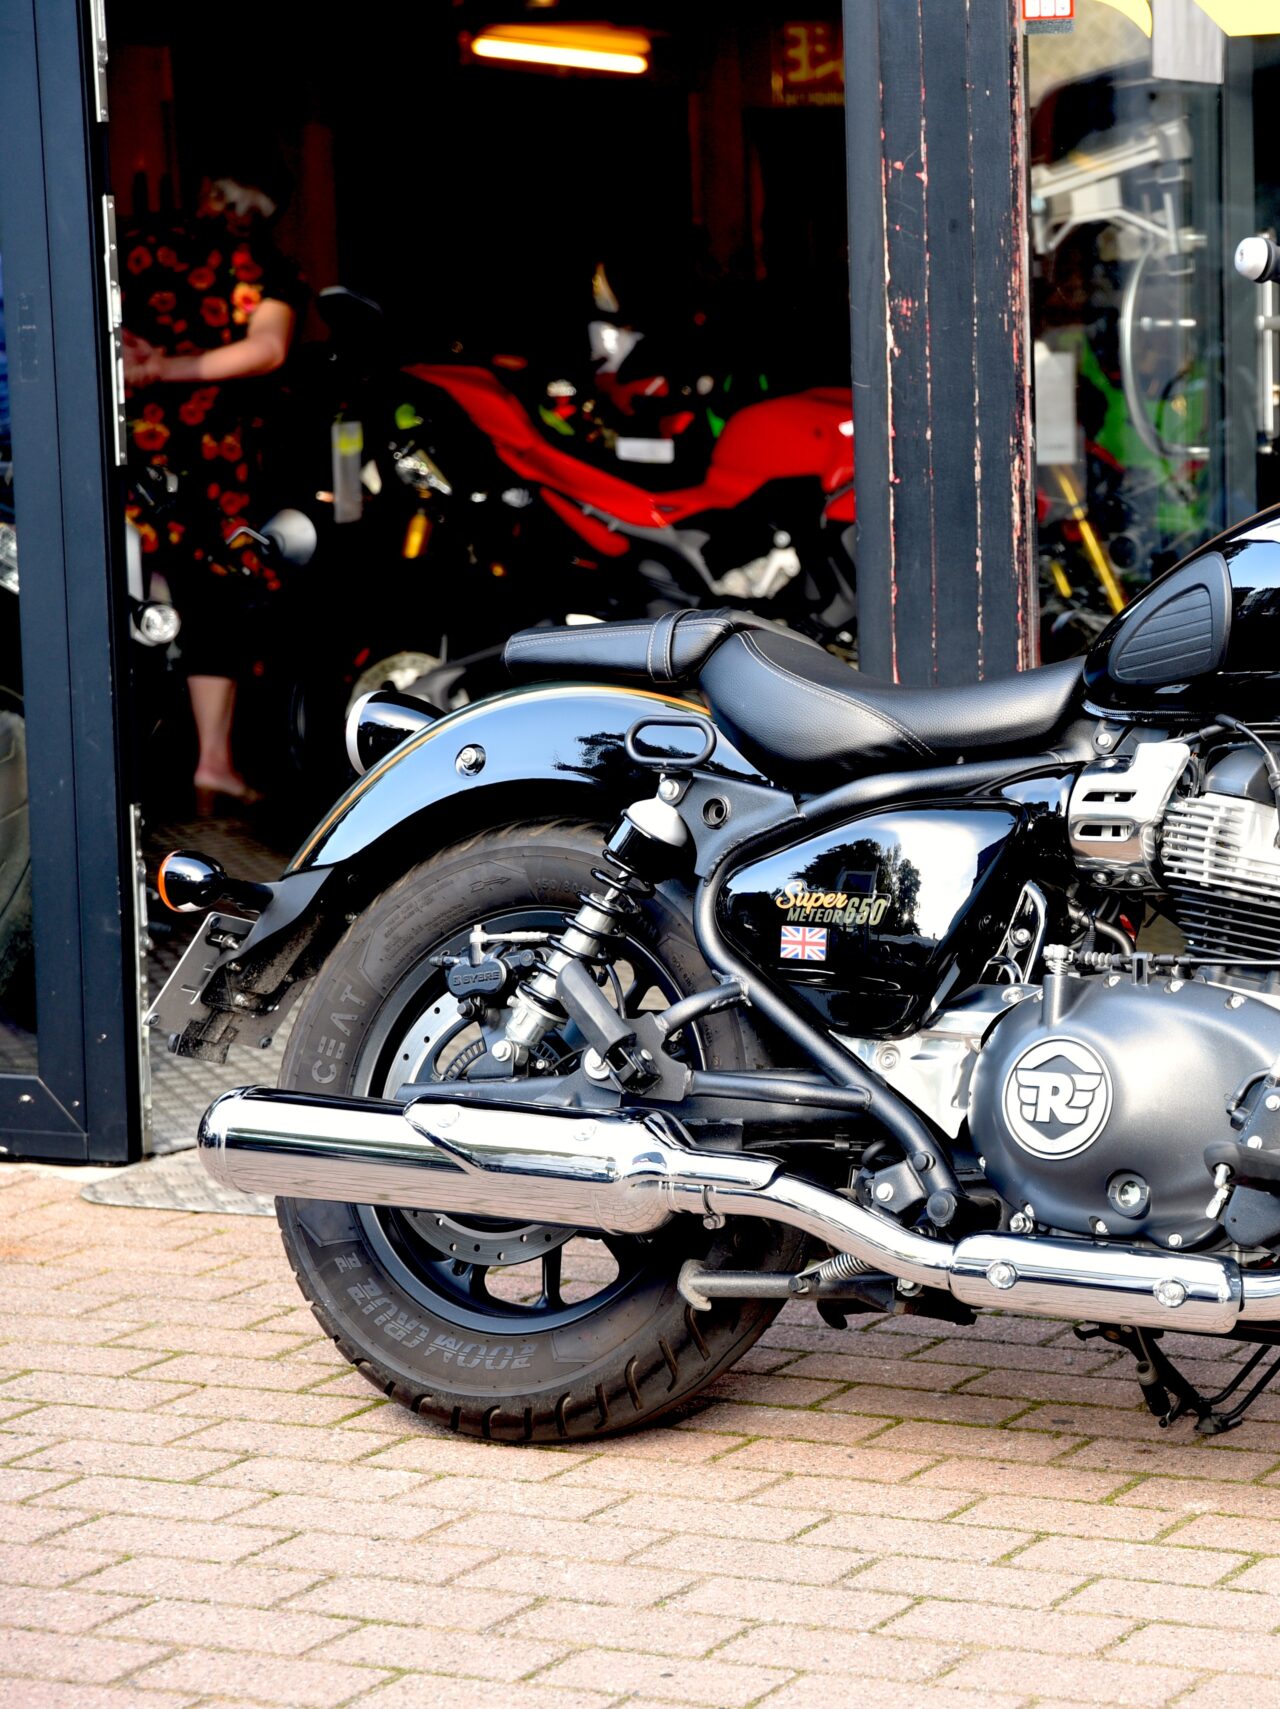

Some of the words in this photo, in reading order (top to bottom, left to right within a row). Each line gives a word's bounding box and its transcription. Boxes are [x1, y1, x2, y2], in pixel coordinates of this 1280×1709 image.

[776, 881, 848, 914] Super
[786, 907, 842, 923] METEOR
[843, 897, 888, 926] 650
[311, 985, 369, 1084] CEAT
[346, 1278, 428, 1348] CRUZ
[423, 1335, 538, 1371] ZOOM
